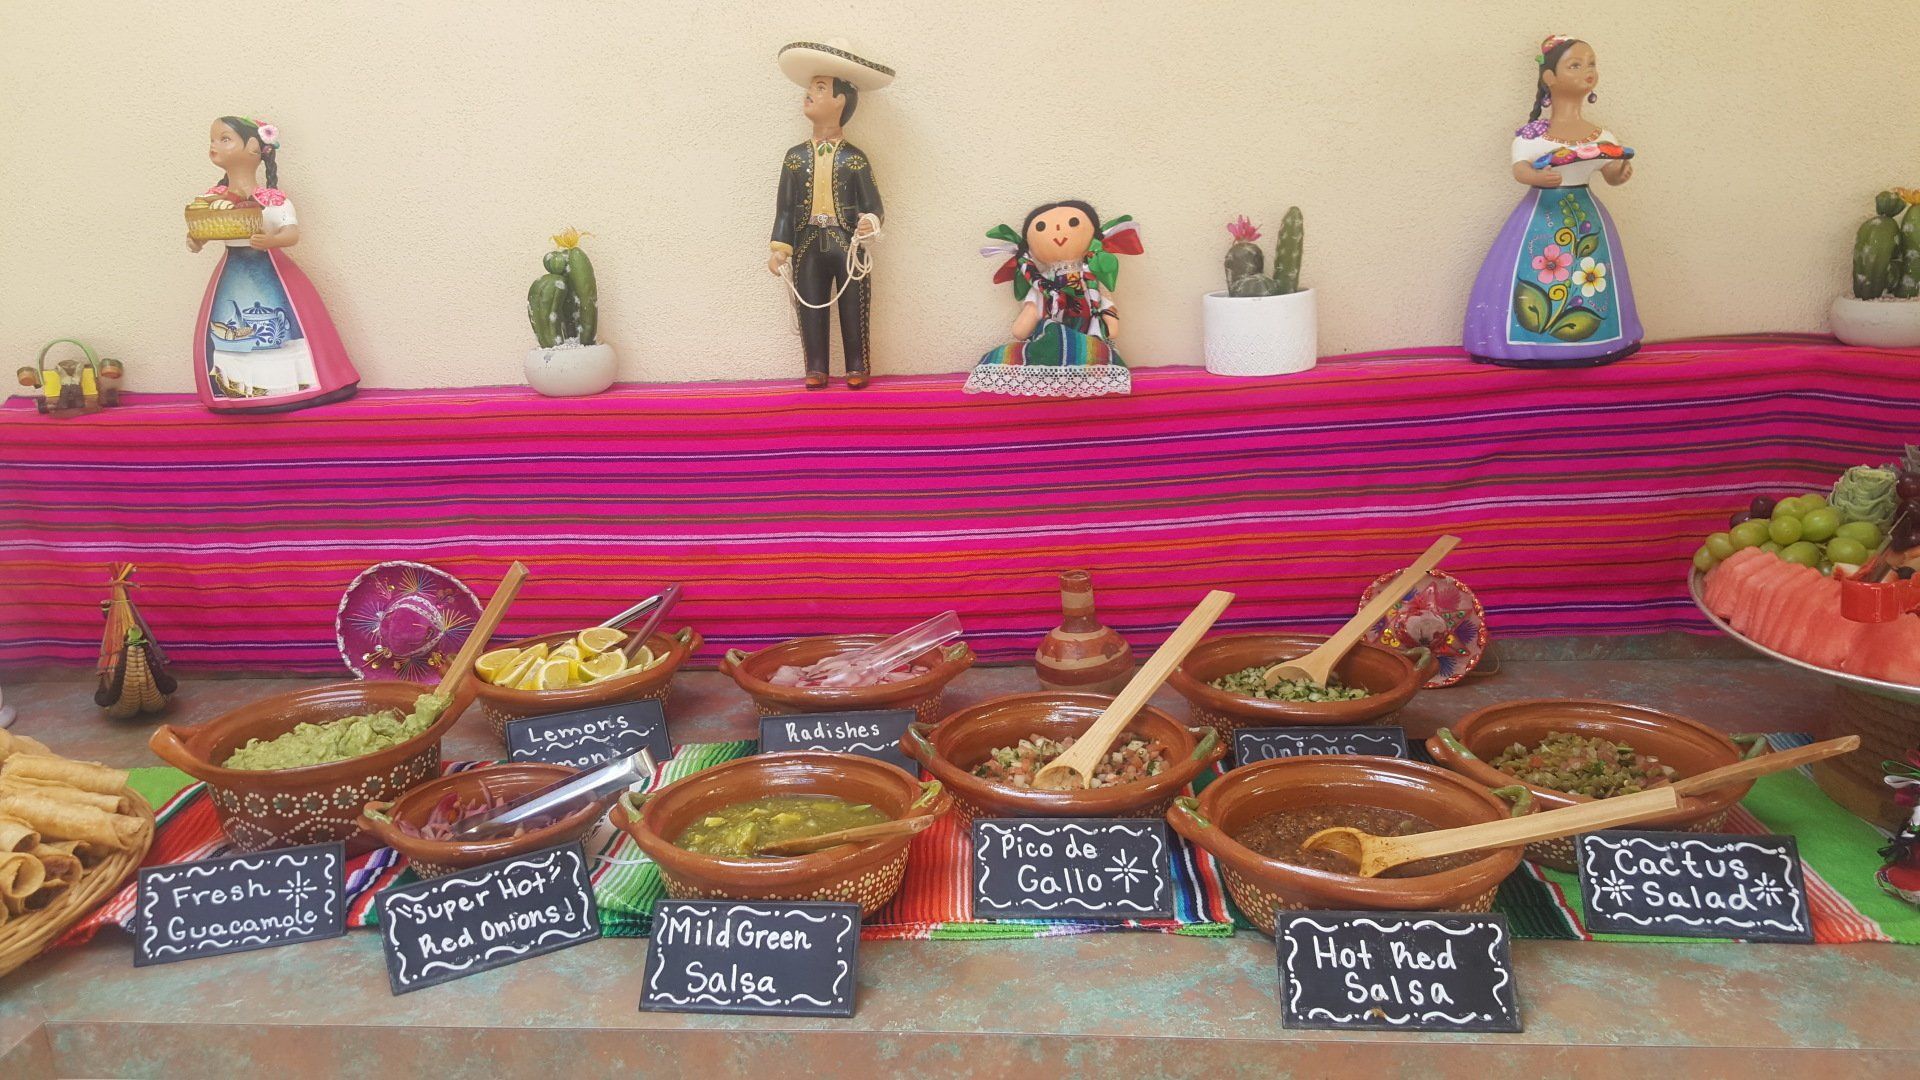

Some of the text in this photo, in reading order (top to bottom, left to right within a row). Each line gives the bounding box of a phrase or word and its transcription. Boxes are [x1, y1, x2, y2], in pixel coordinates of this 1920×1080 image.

[528, 715, 629, 743] Lemons
[785, 721, 880, 743] Radishes
[1002, 833, 1098, 859] Pico de
[1017, 864, 1103, 894] Gallo
[1614, 849, 1749, 880] Cactus
[172, 878, 271, 908] Fresh
[1642, 880, 1758, 911] Salad
[168, 908, 318, 941] Guacamole
[667, 916, 812, 950] Mild Green
[418, 927, 474, 958] Red
[1313, 935, 1457, 970] Hot Red
[685, 961, 776, 993] Salsa
[1344, 971, 1454, 1006] Salsa
